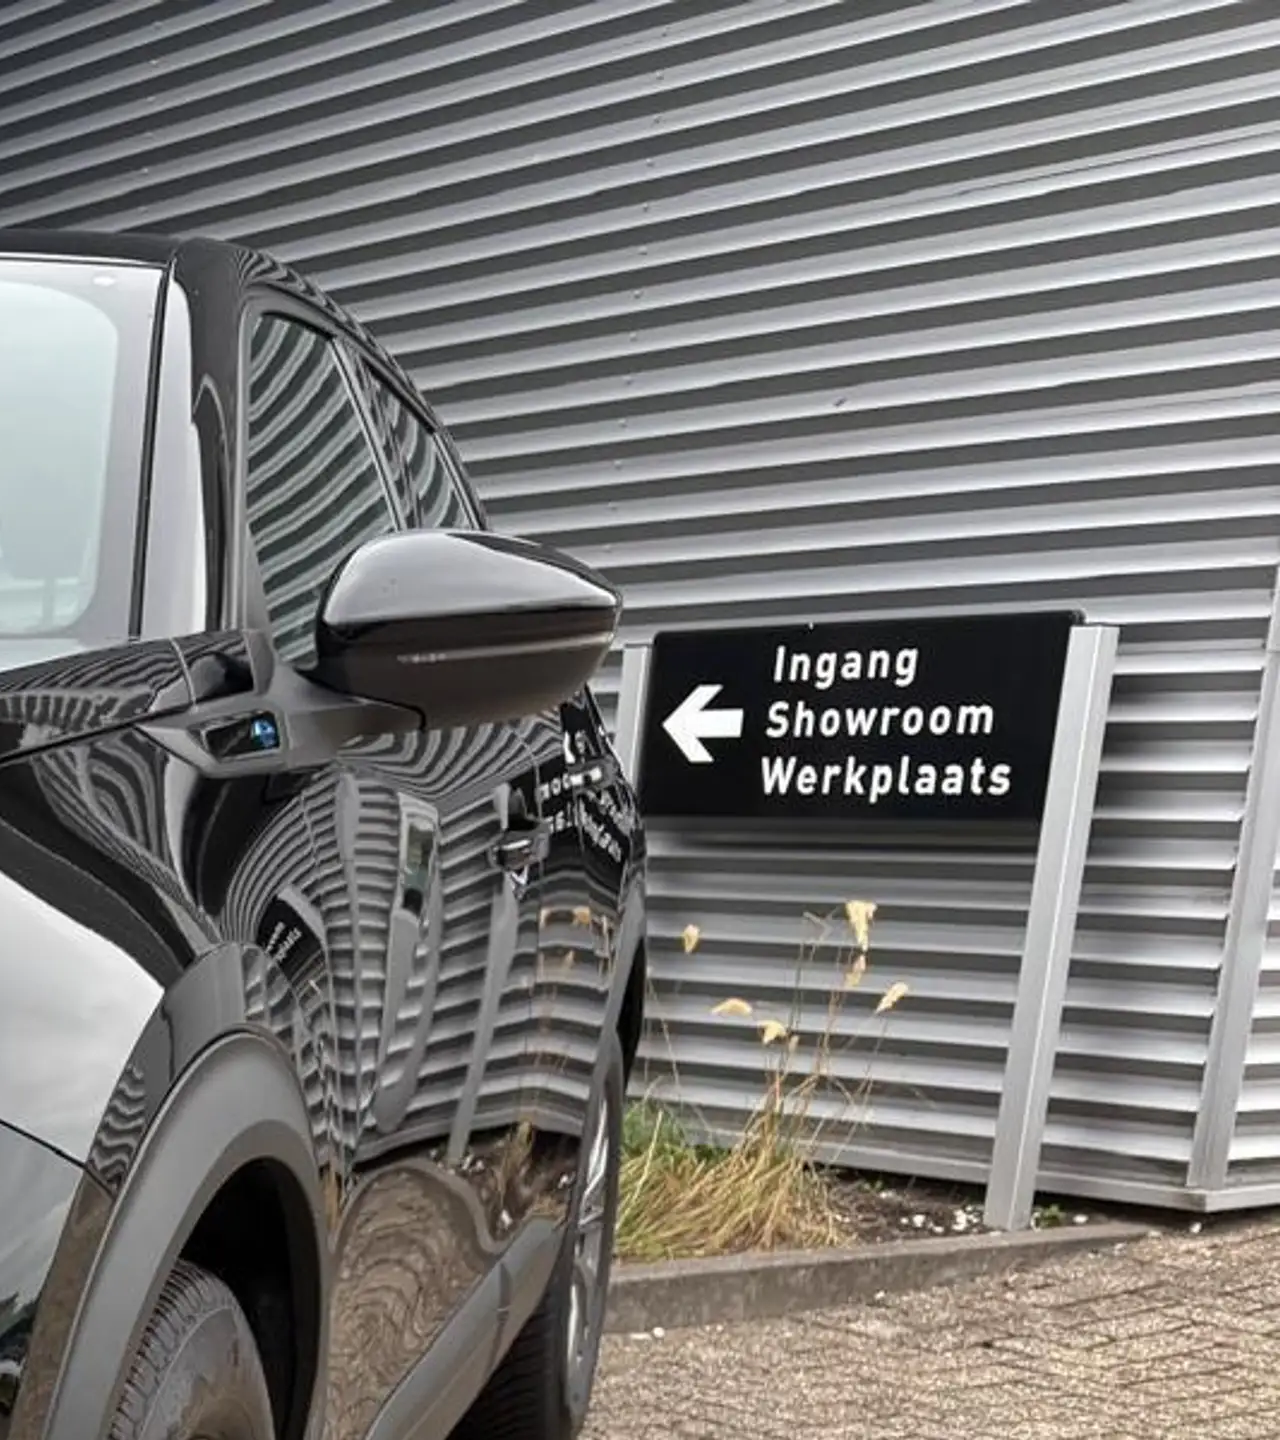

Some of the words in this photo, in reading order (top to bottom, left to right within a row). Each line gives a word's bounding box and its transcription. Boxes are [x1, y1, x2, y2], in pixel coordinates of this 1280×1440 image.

[773, 644, 919, 690] Ingang
[765, 701, 994, 738] Showroom
[760, 754, 1012, 804] Werkplaats
